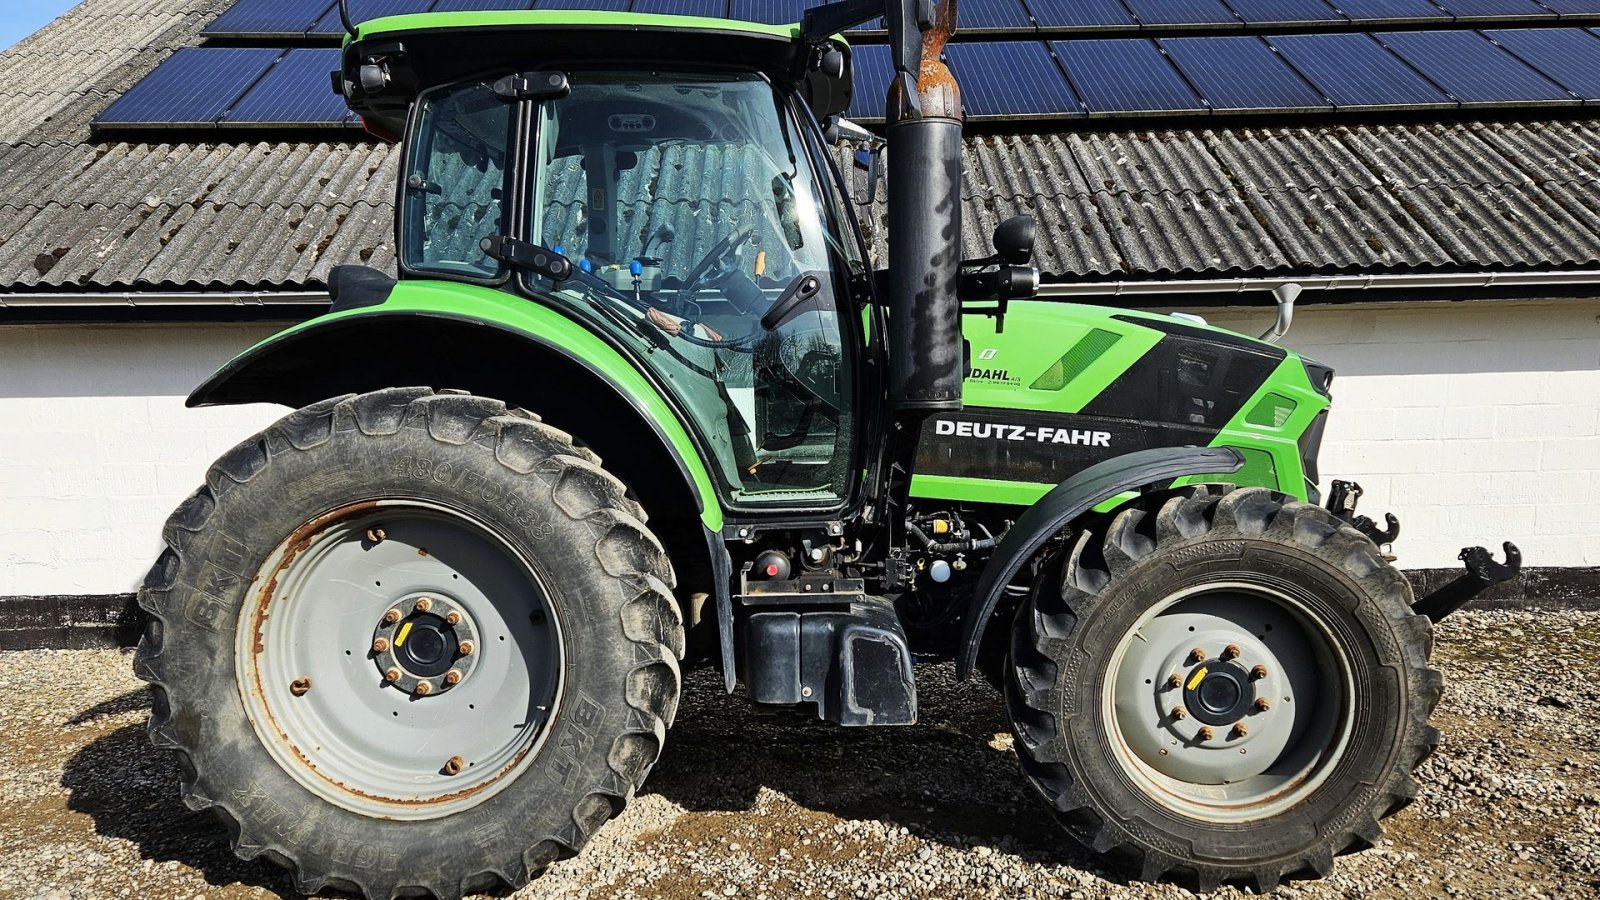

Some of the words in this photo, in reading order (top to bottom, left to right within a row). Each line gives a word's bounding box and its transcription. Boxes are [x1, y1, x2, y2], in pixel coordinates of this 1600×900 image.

[936, 420, 1112, 447] DEUTZ-FAHR
[189, 534, 248, 630] BKT
[548, 693, 603, 789] BKT
